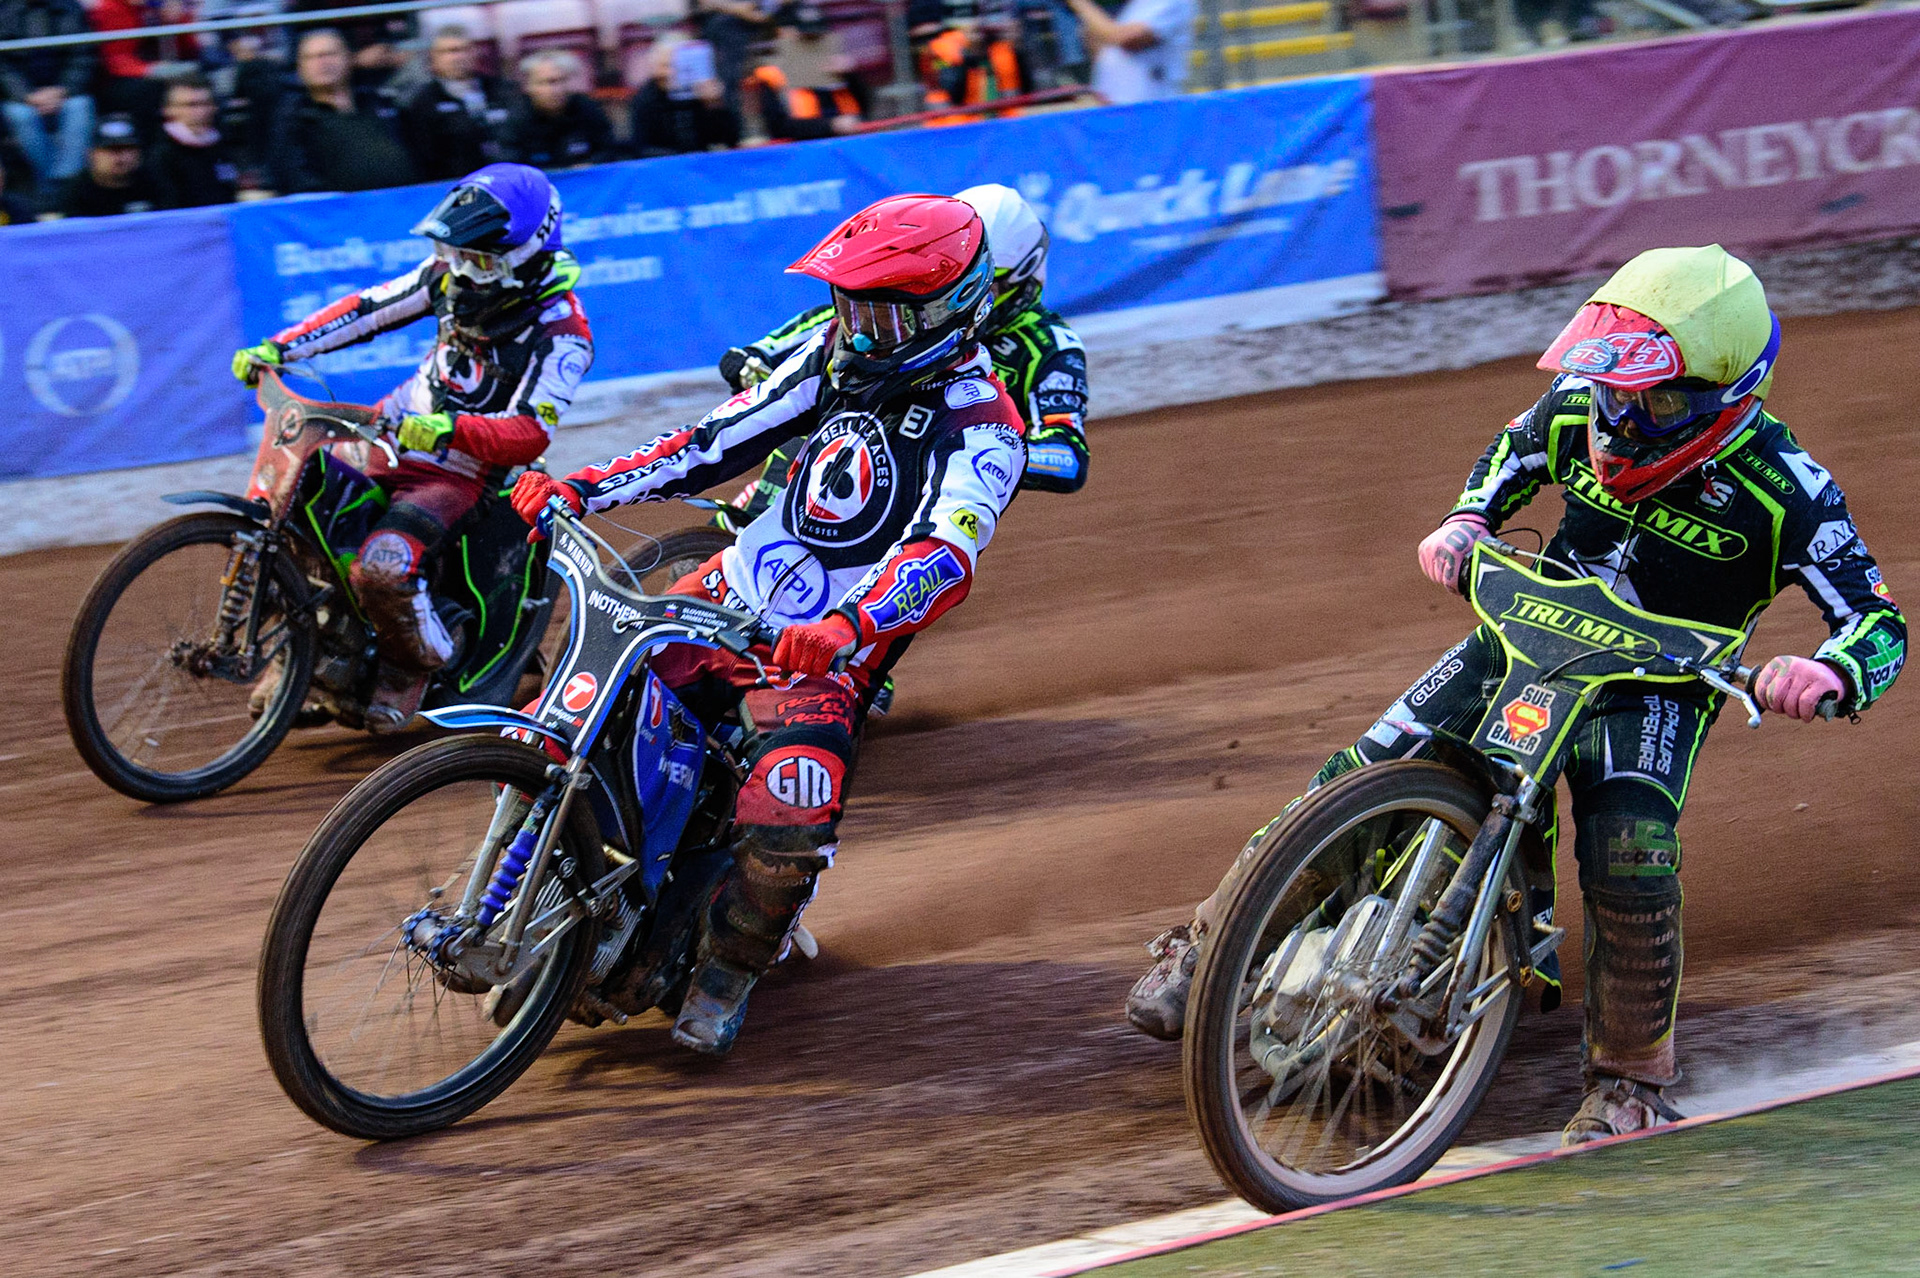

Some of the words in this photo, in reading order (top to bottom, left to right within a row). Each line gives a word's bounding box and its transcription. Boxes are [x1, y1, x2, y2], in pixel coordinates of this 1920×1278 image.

[1568, 348, 1609, 364] STS
[870, 444, 890, 488] ACES
[1763, 468, 1790, 492] MIX
[1646, 507, 1732, 554] MIX
[764, 557, 814, 604] ATPI
[1516, 599, 1577, 629] TRU
[1573, 618, 1647, 655] MIX
[1412, 659, 1463, 706] GLASS
[1522, 686, 1551, 708] SUE
[1637, 735, 1657, 772] HIRE
[766, 756, 832, 808] GM
